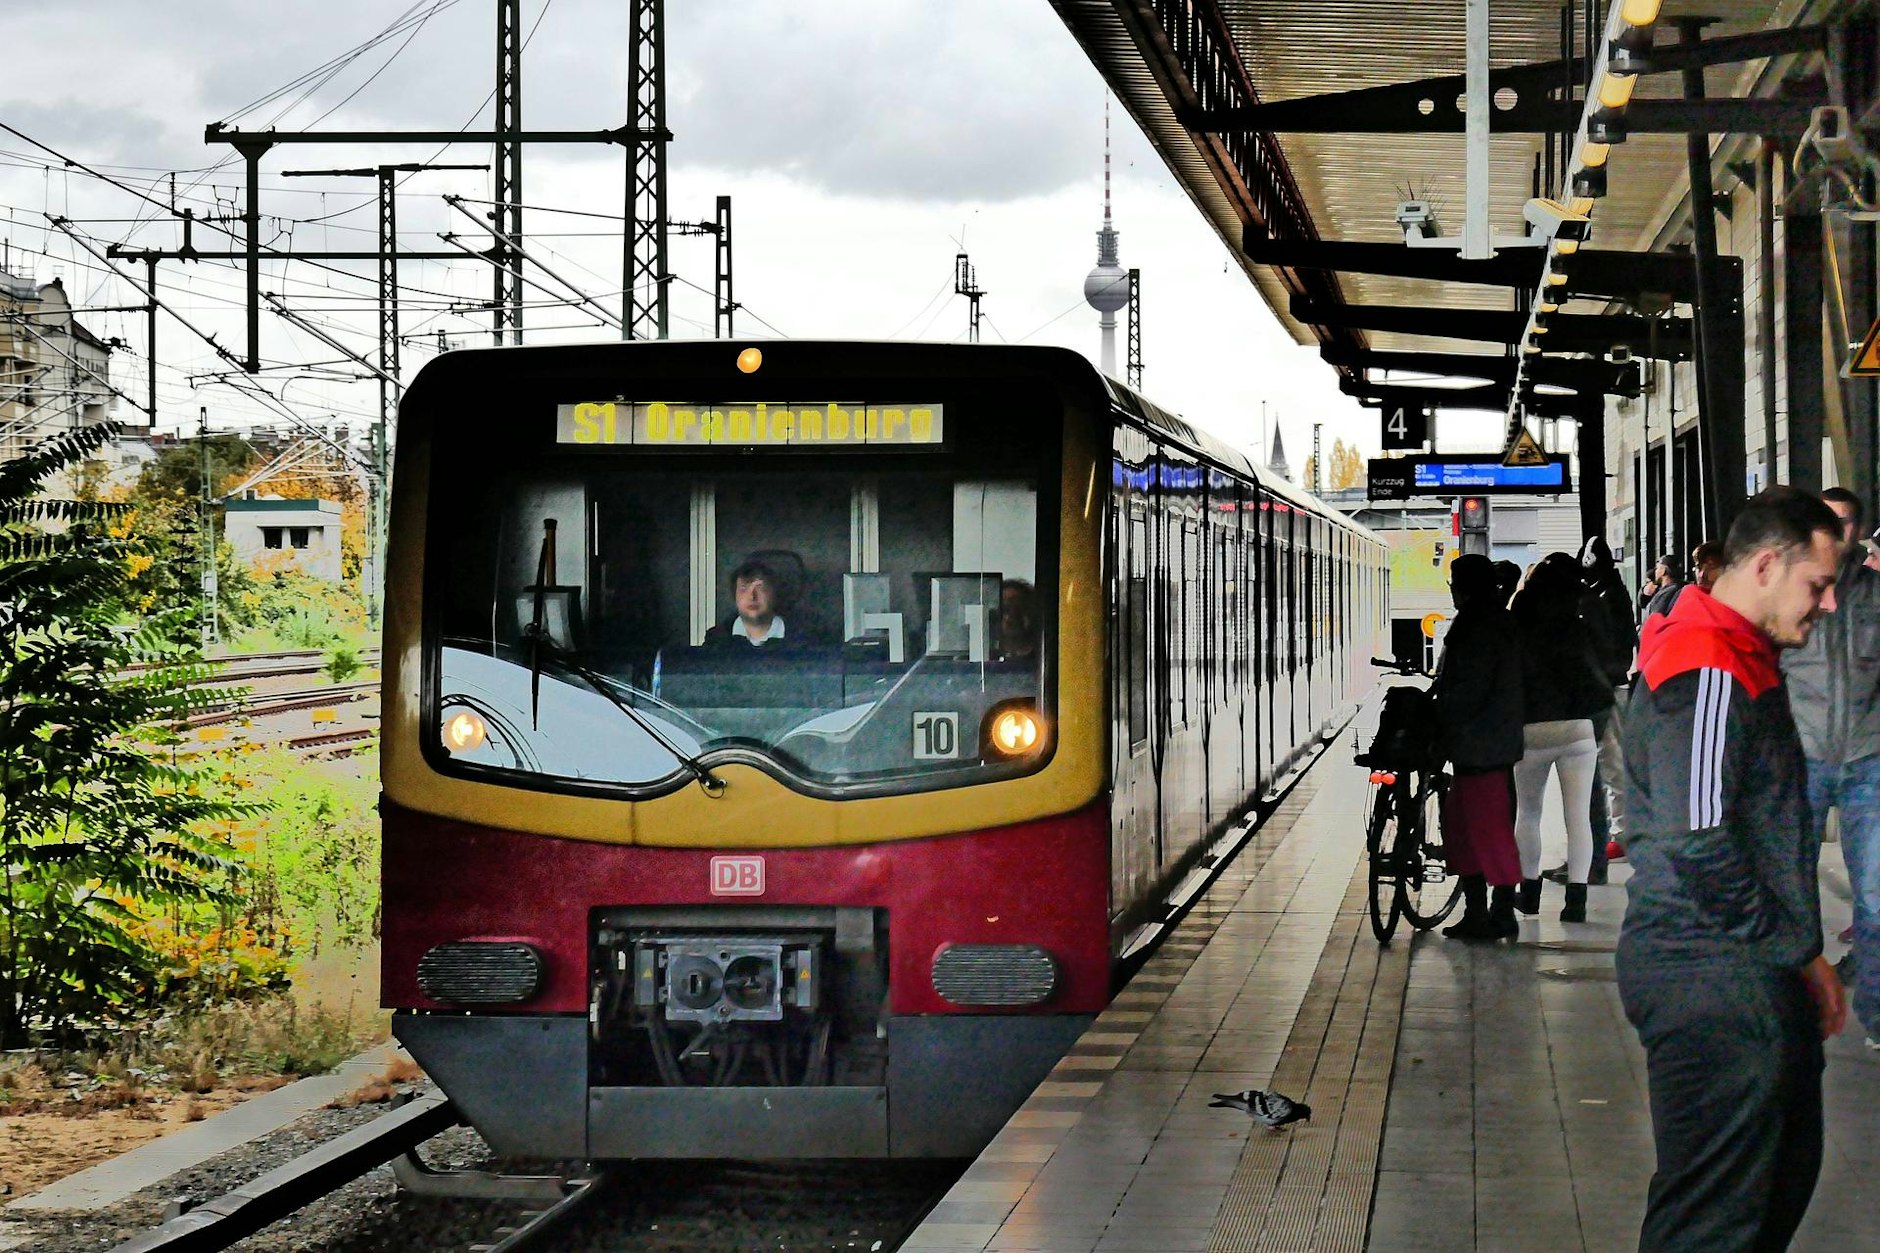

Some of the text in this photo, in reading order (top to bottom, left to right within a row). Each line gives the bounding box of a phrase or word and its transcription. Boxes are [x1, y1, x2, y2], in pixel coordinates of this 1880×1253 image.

[574, 402, 932, 443] S1 Oranienburg
[1387, 407, 1408, 440] 4
[1415, 464, 1426, 474] S1
[1372, 478, 1405, 487] Kurzzug
[1372, 488, 1392, 496] Ende
[917, 717, 954, 755] 10
[718, 863, 758, 888] DB
